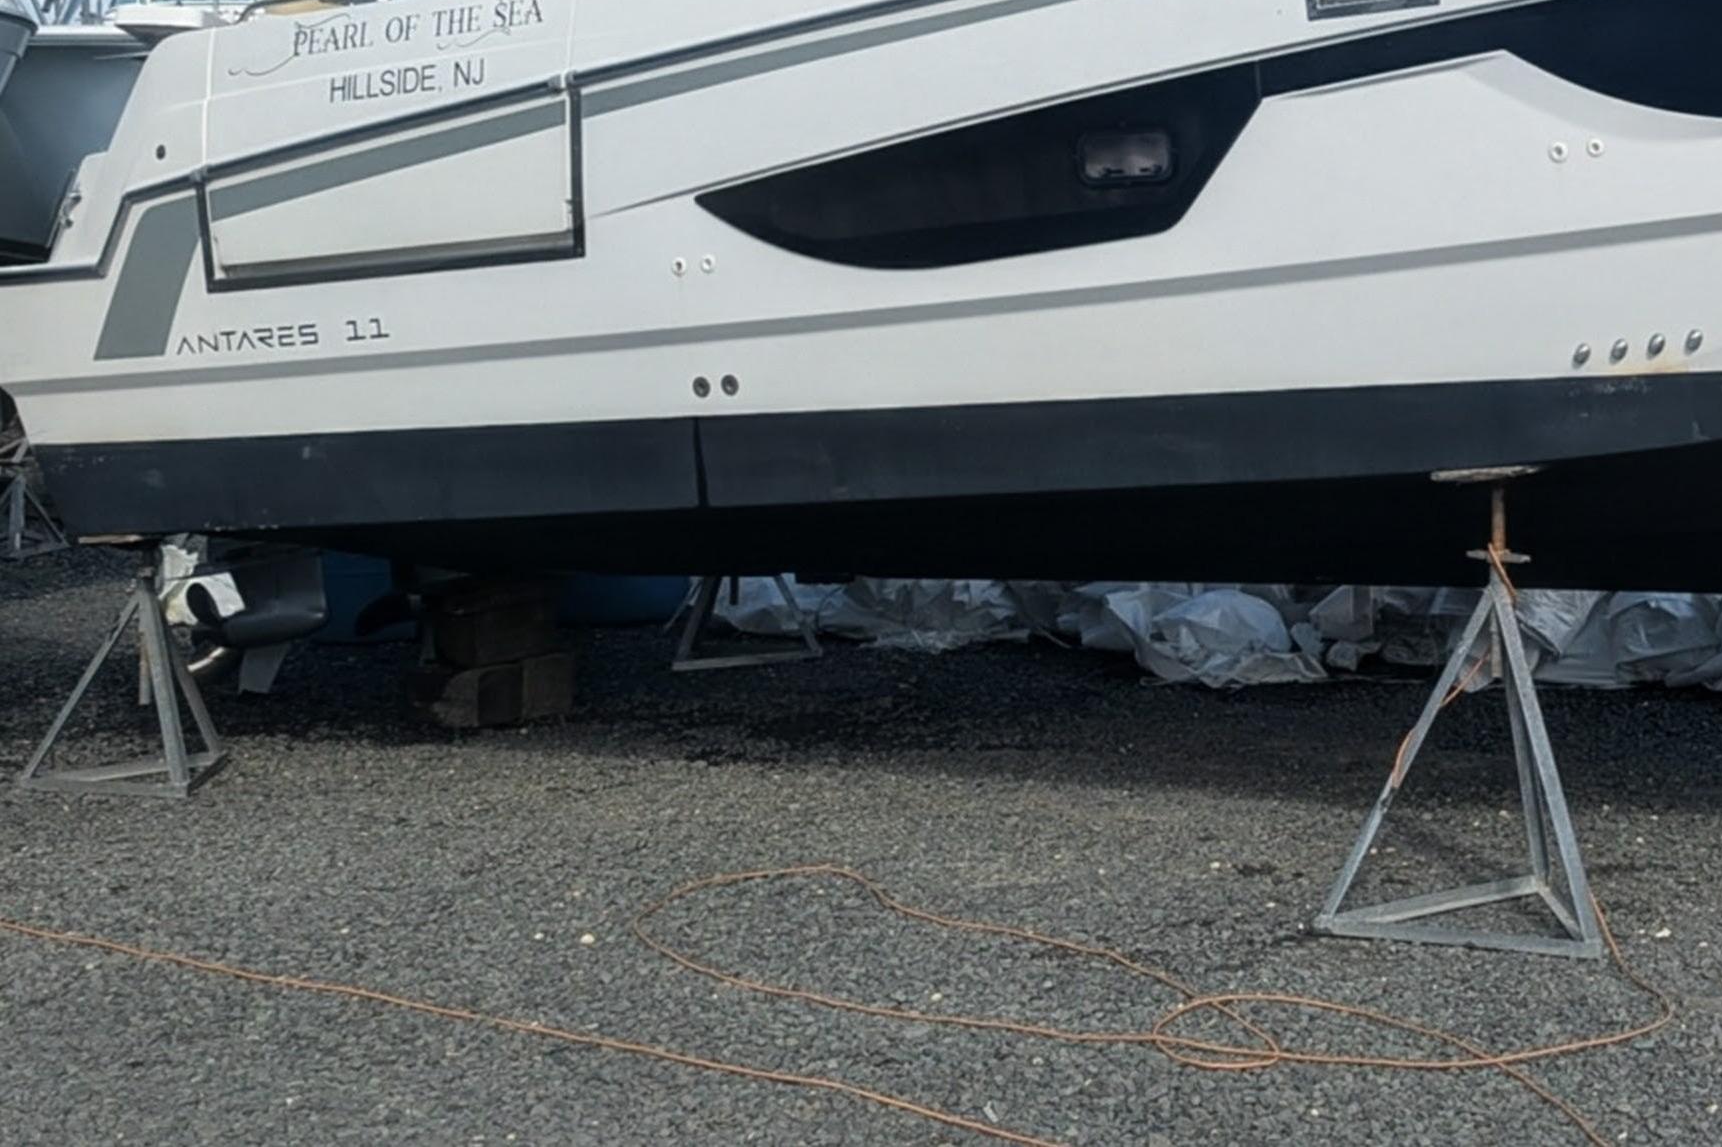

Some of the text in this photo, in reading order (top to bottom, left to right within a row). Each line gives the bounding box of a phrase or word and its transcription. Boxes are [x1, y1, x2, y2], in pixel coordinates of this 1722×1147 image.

[291, 21, 374, 57] PEARL
[385, 13, 421, 43] OF
[432, 5, 484, 39] THE
[328, 57, 486, 104] HILLSIDE, NJ
[176, 317, 390, 356] ANTARES 11
